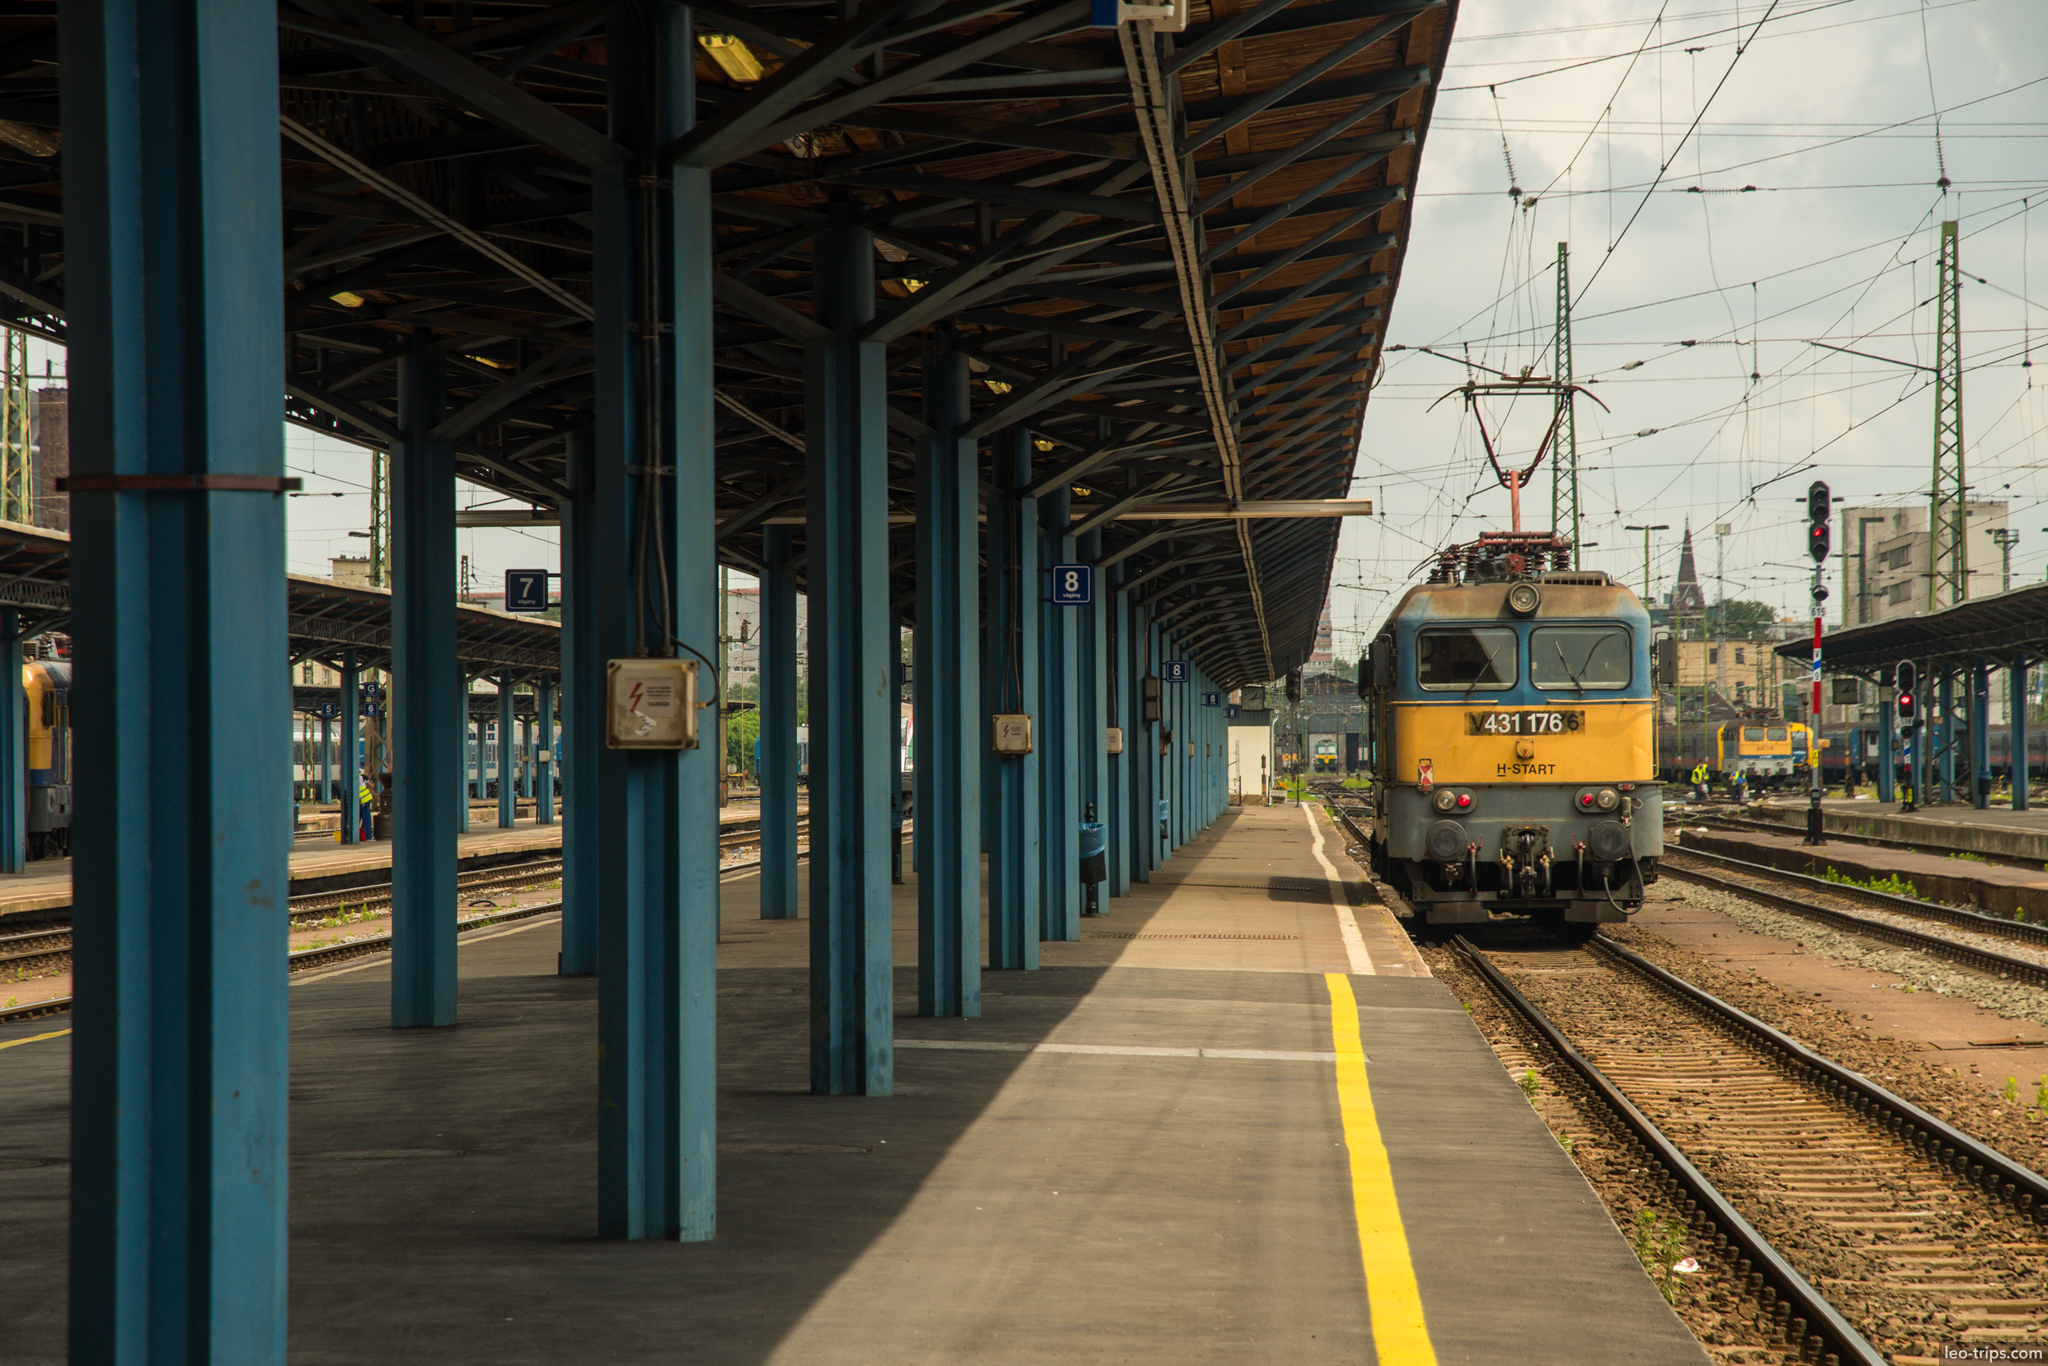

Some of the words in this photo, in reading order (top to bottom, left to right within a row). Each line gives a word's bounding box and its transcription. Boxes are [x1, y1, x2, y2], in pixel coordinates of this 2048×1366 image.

[1065, 571, 1079, 592] 8
[520, 577, 534, 598] 7
[1811, 607, 1826, 616] 615
[1173, 664, 1181, 676] 8
[367, 684, 376, 693] G
[1210, 694, 1216, 703] 8
[326, 704, 332, 713] 5
[368, 704, 374, 712] 6
[1497, 763, 1556, 777] H-START
